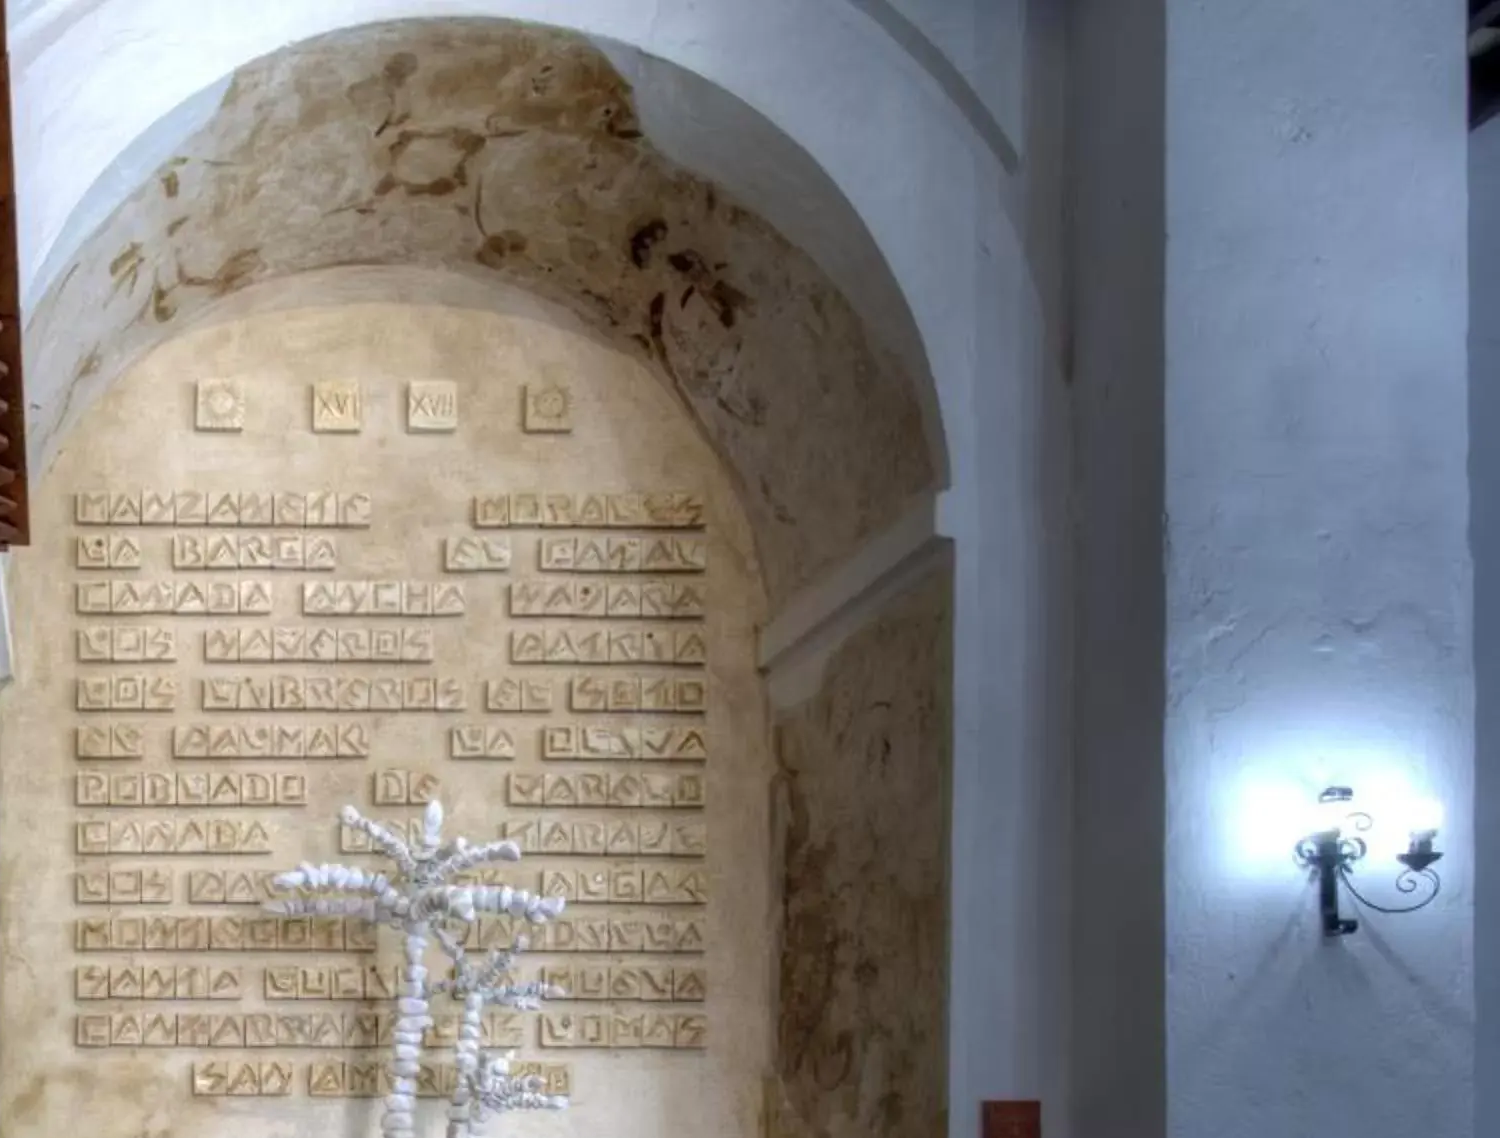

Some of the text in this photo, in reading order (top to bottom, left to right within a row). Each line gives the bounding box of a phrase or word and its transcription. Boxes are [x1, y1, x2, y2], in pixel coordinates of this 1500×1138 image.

[80, 492, 371, 523] MANZANETE
[81, 536, 139, 563] LA
[179, 534, 335, 563] BARCA
[307, 583, 464, 612] ANCHA
[80, 630, 171, 658] LOS
[208, 628, 430, 660] NAVEROS
[81, 678, 176, 706] LOS
[180, 726, 368, 754] PALMAR
[83, 774, 305, 802] POBLADO
[80, 871, 169, 899] LOS
[82, 967, 238, 996] SANTA
[268, 967, 396, 996] LUCI
[198, 1064, 292, 1092] SAN
